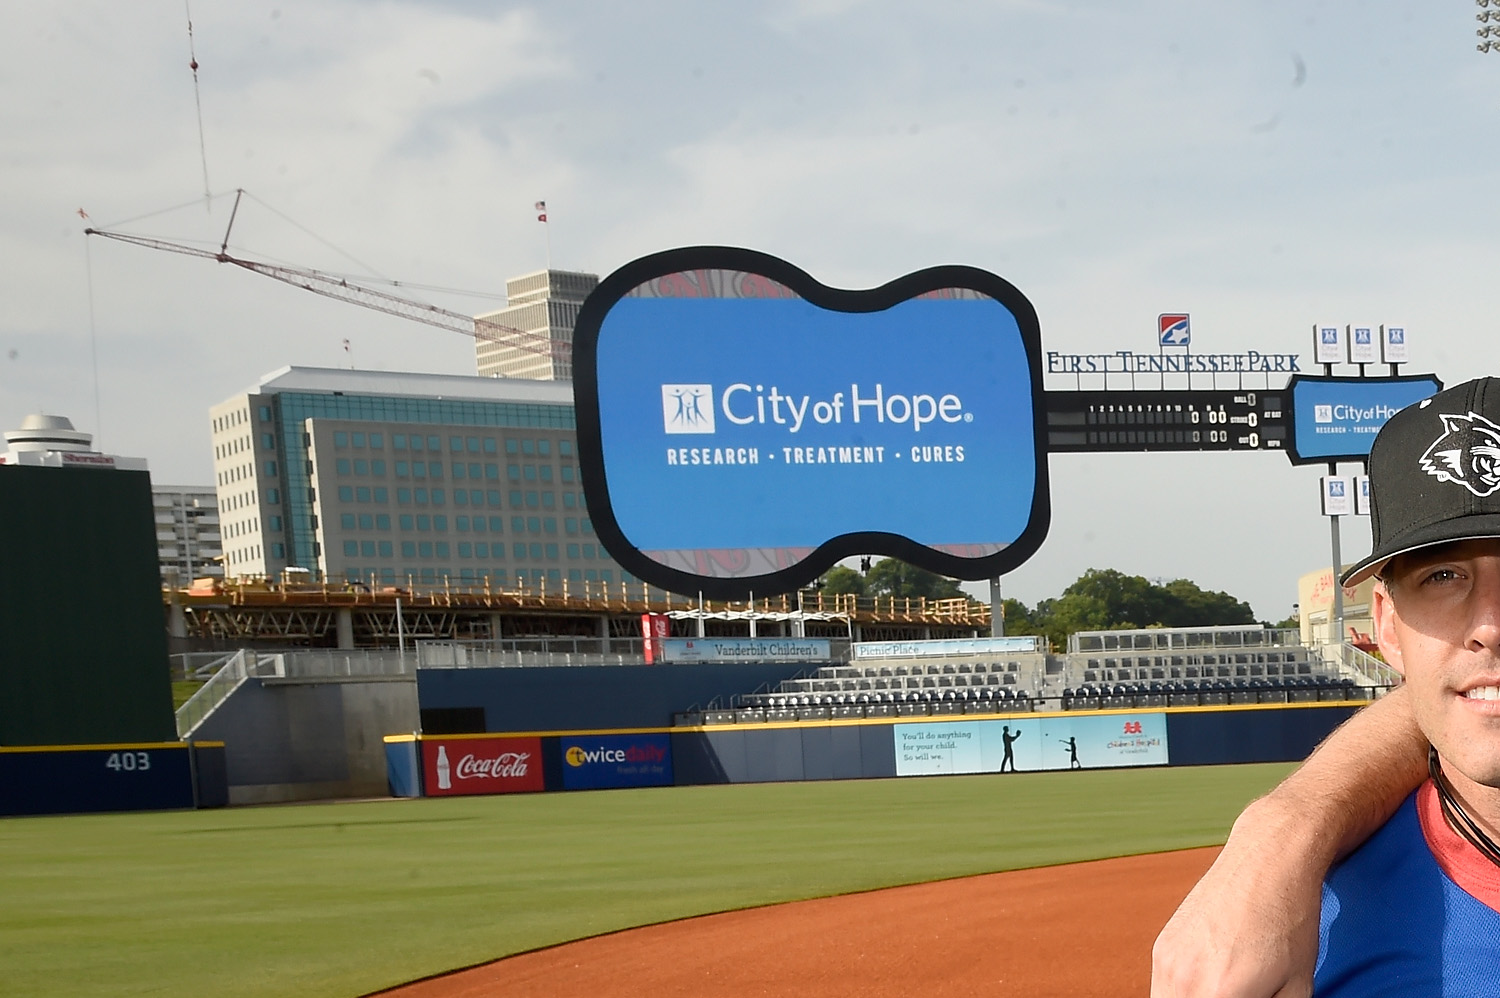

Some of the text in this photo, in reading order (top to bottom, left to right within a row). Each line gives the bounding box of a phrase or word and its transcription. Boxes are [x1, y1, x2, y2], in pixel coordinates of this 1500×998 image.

[1047, 352, 1112, 373] FIRST
[1116, 351, 1243, 372] TENNESSEE
[1248, 351, 1301, 372] PARK
[722, 383, 809, 432] City
[813, 393, 843, 423] of
[1333, 405, 1363, 422] City
[1363, 408, 1374, 419] of
[668, 445, 965, 465] RESEARCH TREATMENT CURES
[715, 643, 768, 656] Vanderbilt
[770, 642, 818, 656] Children's
[860, 645, 919, 656] Picnic Place
[902, 731, 924, 740] You'll
[937, 731, 972, 740] anything
[571, 745, 665, 764] twice daily
[903, 743, 915, 751] for
[935, 741, 957, 749] child.
[106, 752, 150, 771] 403
[456, 752, 531, 779] Coca-Cola
